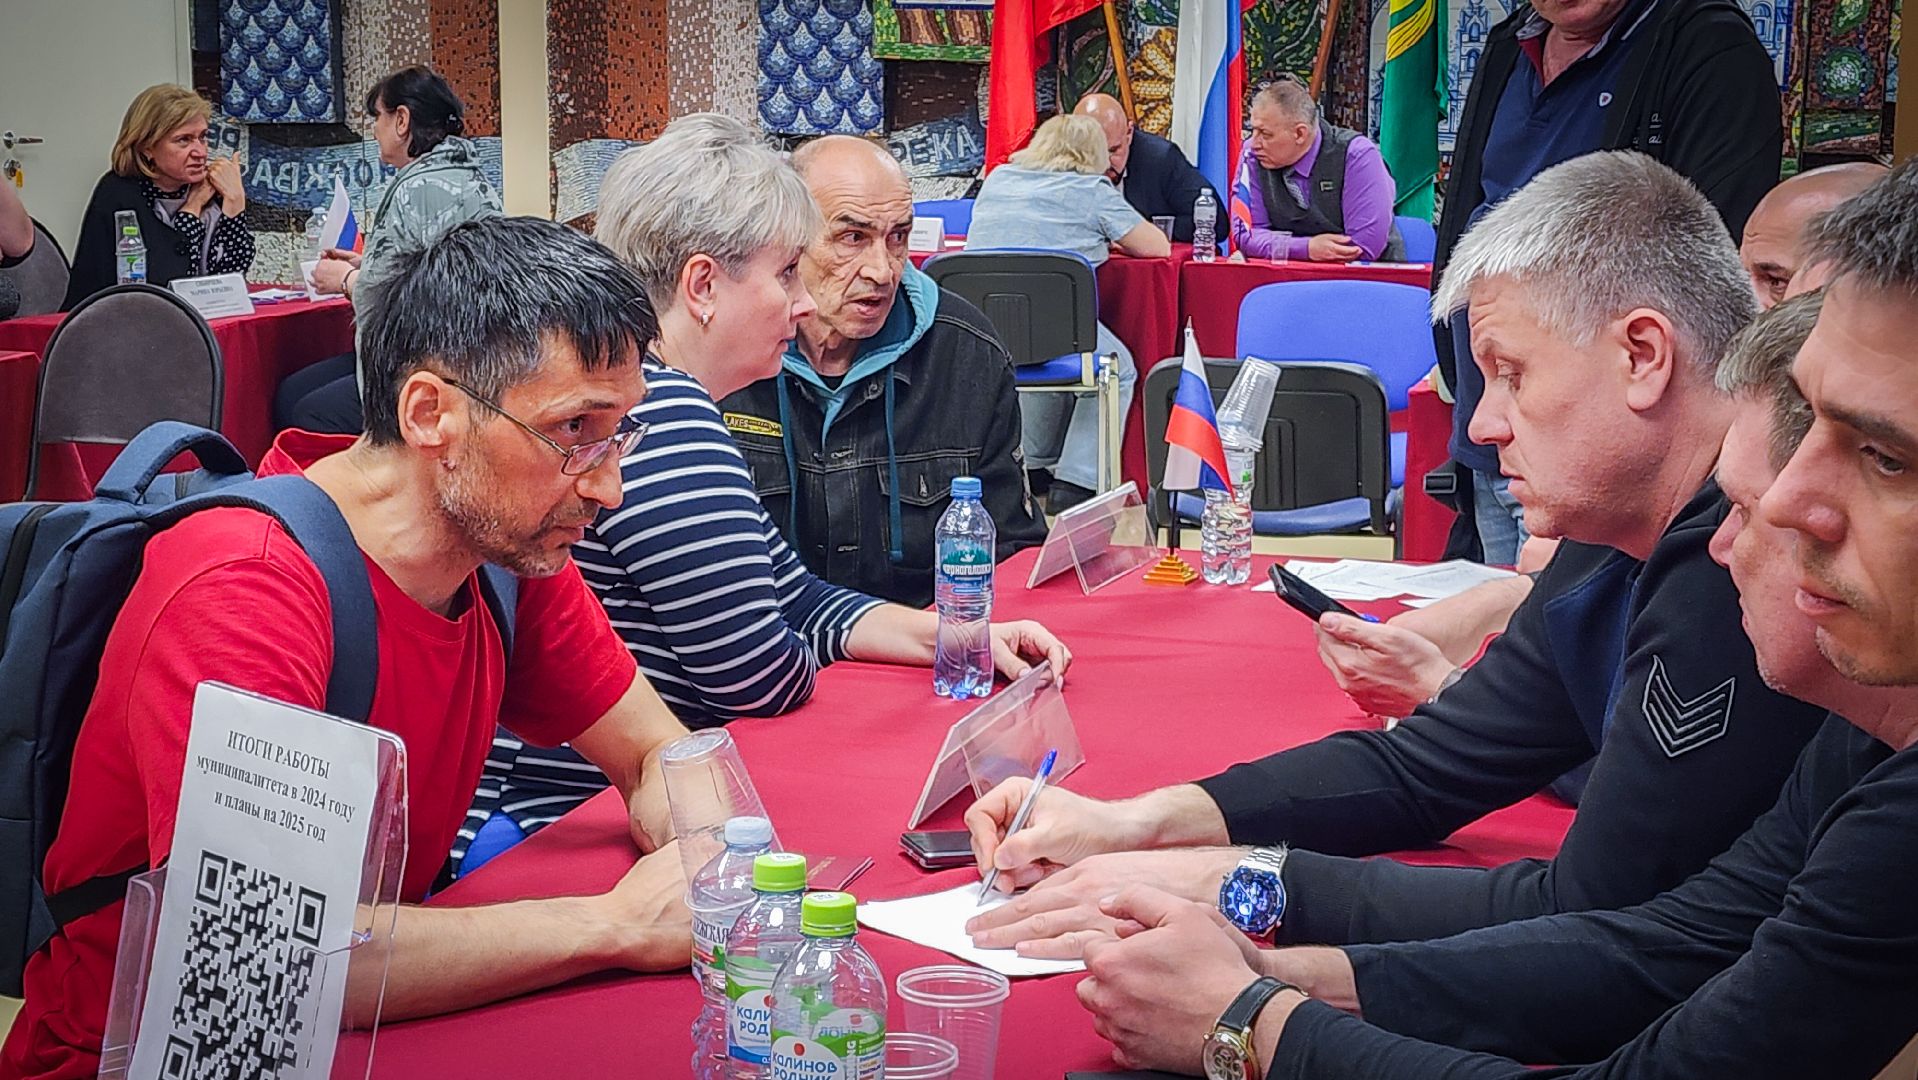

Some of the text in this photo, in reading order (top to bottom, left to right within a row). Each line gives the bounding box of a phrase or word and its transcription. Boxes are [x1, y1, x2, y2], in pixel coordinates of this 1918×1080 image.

[226, 730, 331, 779] ИТОГИ РАБОТЫ
[196, 755, 355, 823] муниципалитета в 2024 году
[214, 791, 327, 843] и планы на 2025 год
[736, 1006, 771, 1021] КАЛИ
[740, 1020, 769, 1036] РОД
